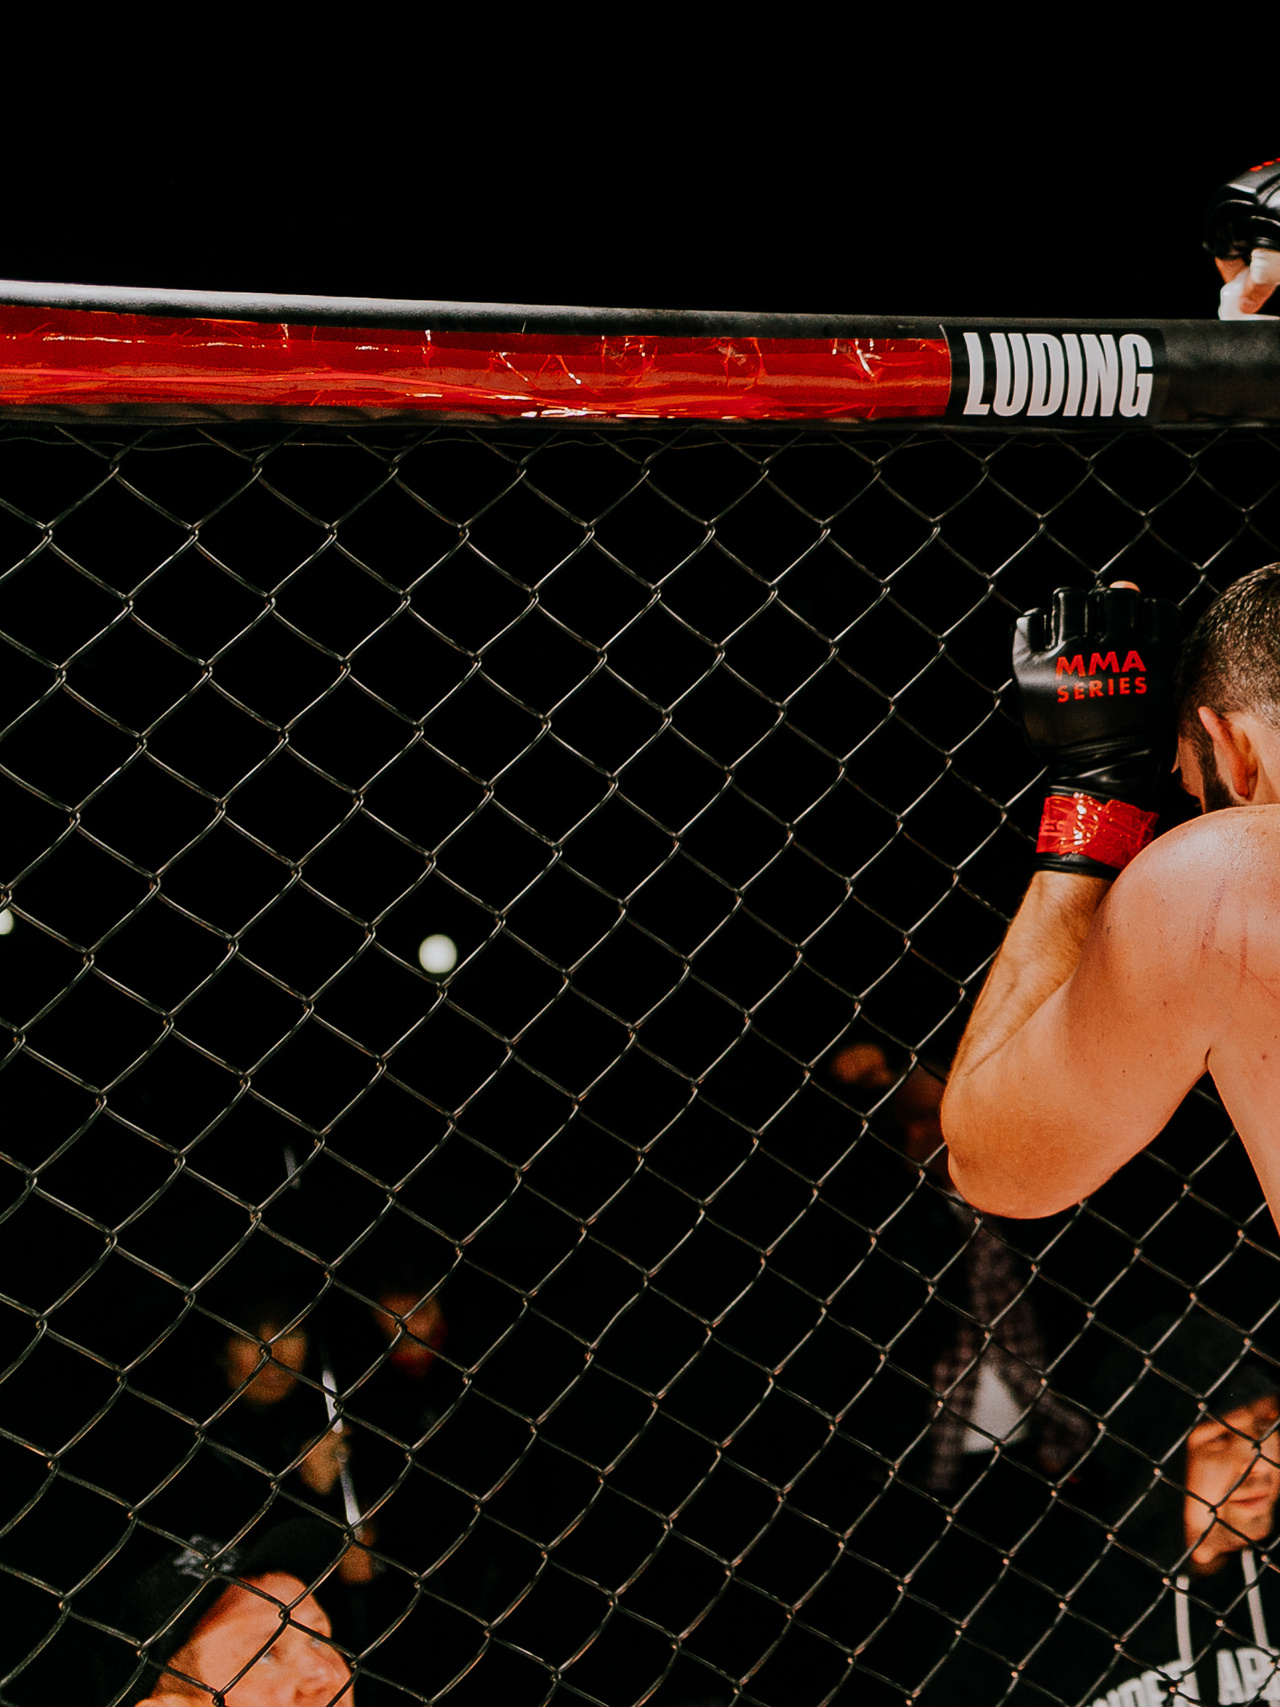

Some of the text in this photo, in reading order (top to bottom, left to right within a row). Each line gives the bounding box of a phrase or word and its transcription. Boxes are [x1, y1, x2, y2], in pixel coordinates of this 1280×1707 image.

[963, 332, 1154, 417] LUDING
[1055, 650, 1147, 680] MMA
[1056, 676, 1148, 703] SERIES
